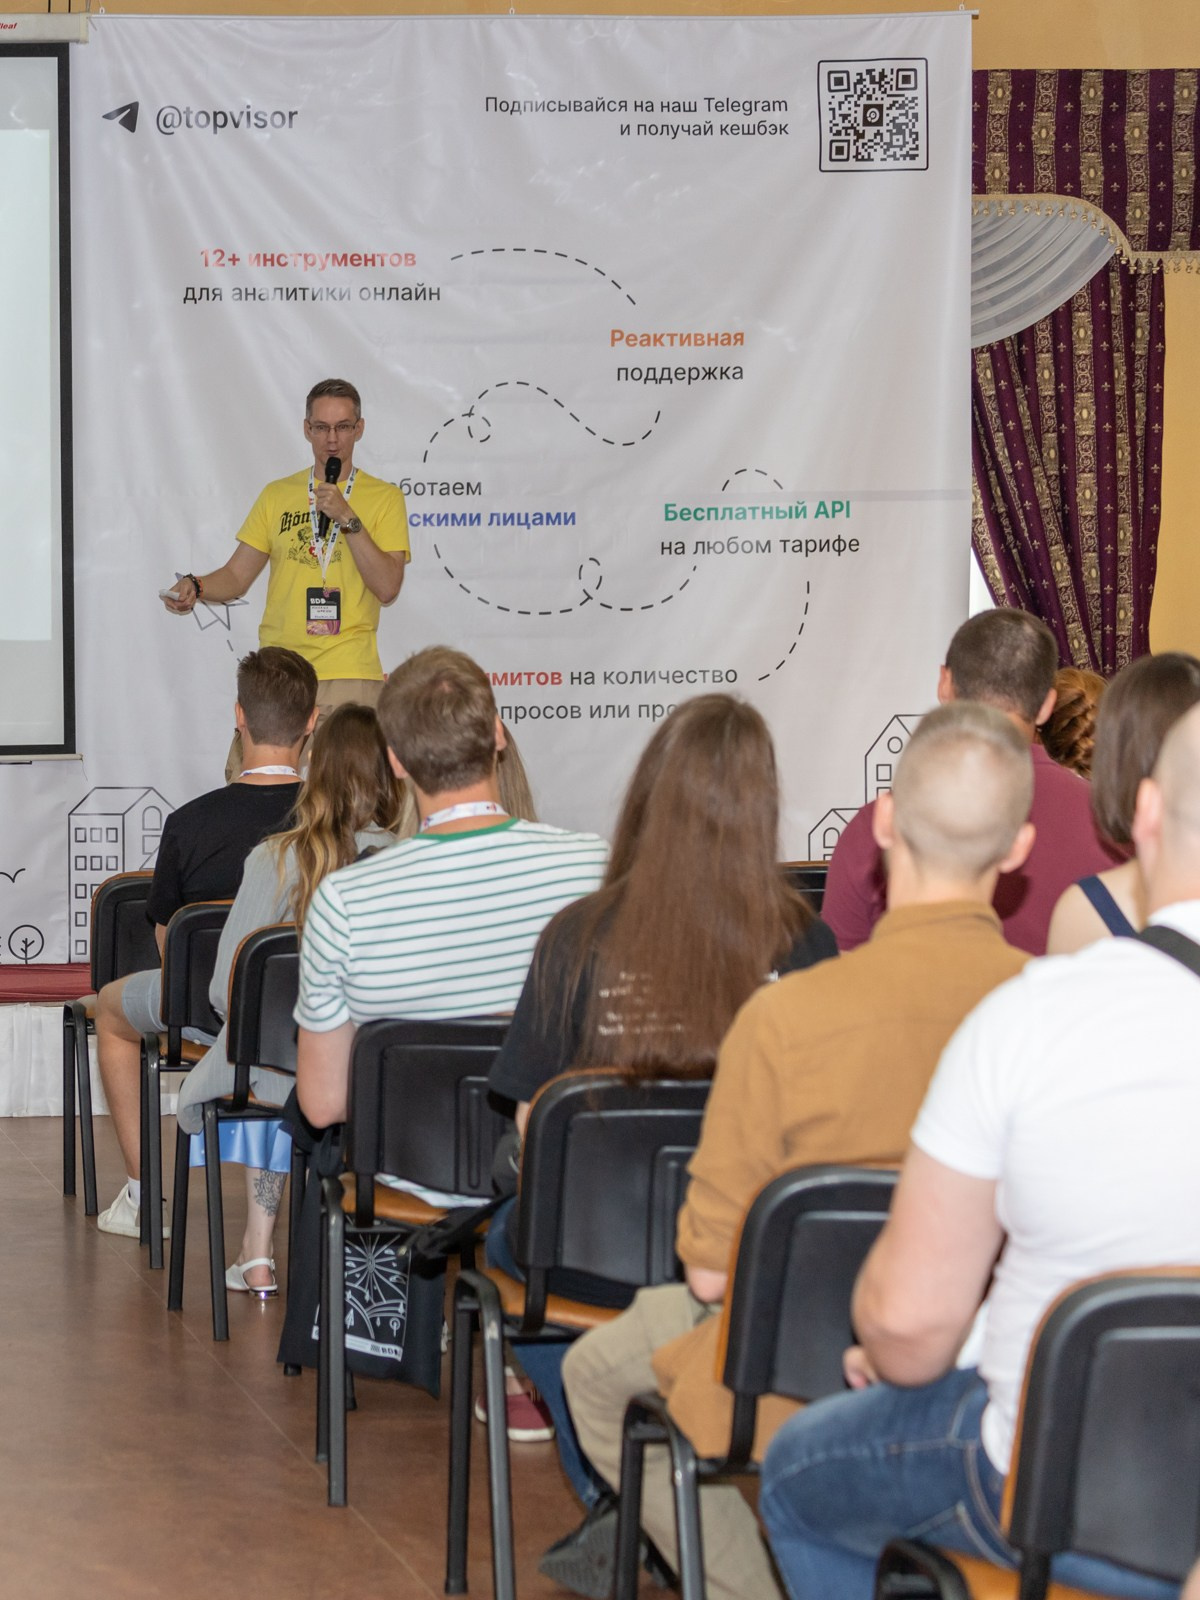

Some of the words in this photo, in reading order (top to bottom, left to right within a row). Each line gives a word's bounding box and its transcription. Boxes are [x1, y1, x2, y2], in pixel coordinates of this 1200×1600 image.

[485, 97, 628, 116] Подписывайся
[634, 99, 655, 113] на
[660, 98, 698, 113] наш
[704, 97, 788, 116] Telegram
[156, 105, 298, 136] @topvisor
[620, 122, 631, 136] и
[637, 119, 714, 140] получай
[719, 119, 790, 136] кешбэк
[200, 249, 241, 268] 12+
[248, 252, 417, 272] инструментов
[183, 286, 223, 304] для
[231, 286, 350, 301] аналитики
[358, 283, 441, 301] онлайн
[610, 328, 745, 347] Реактивная
[617, 365, 744, 385] поддержка
[390, 478, 483, 497] ботаем
[408, 512, 482, 528] скими
[487, 511, 577, 530] лицами
[664, 500, 807, 521] Бесплатный
[814, 500, 850, 519] API
[660, 541, 686, 555] на
[693, 536, 771, 554] любом
[779, 534, 860, 557] тарифе
[484, 671, 563, 686] митов
[570, 671, 595, 686] на
[603, 669, 738, 685] количество
[501, 705, 582, 724] просов
[589, 704, 630, 718] или
